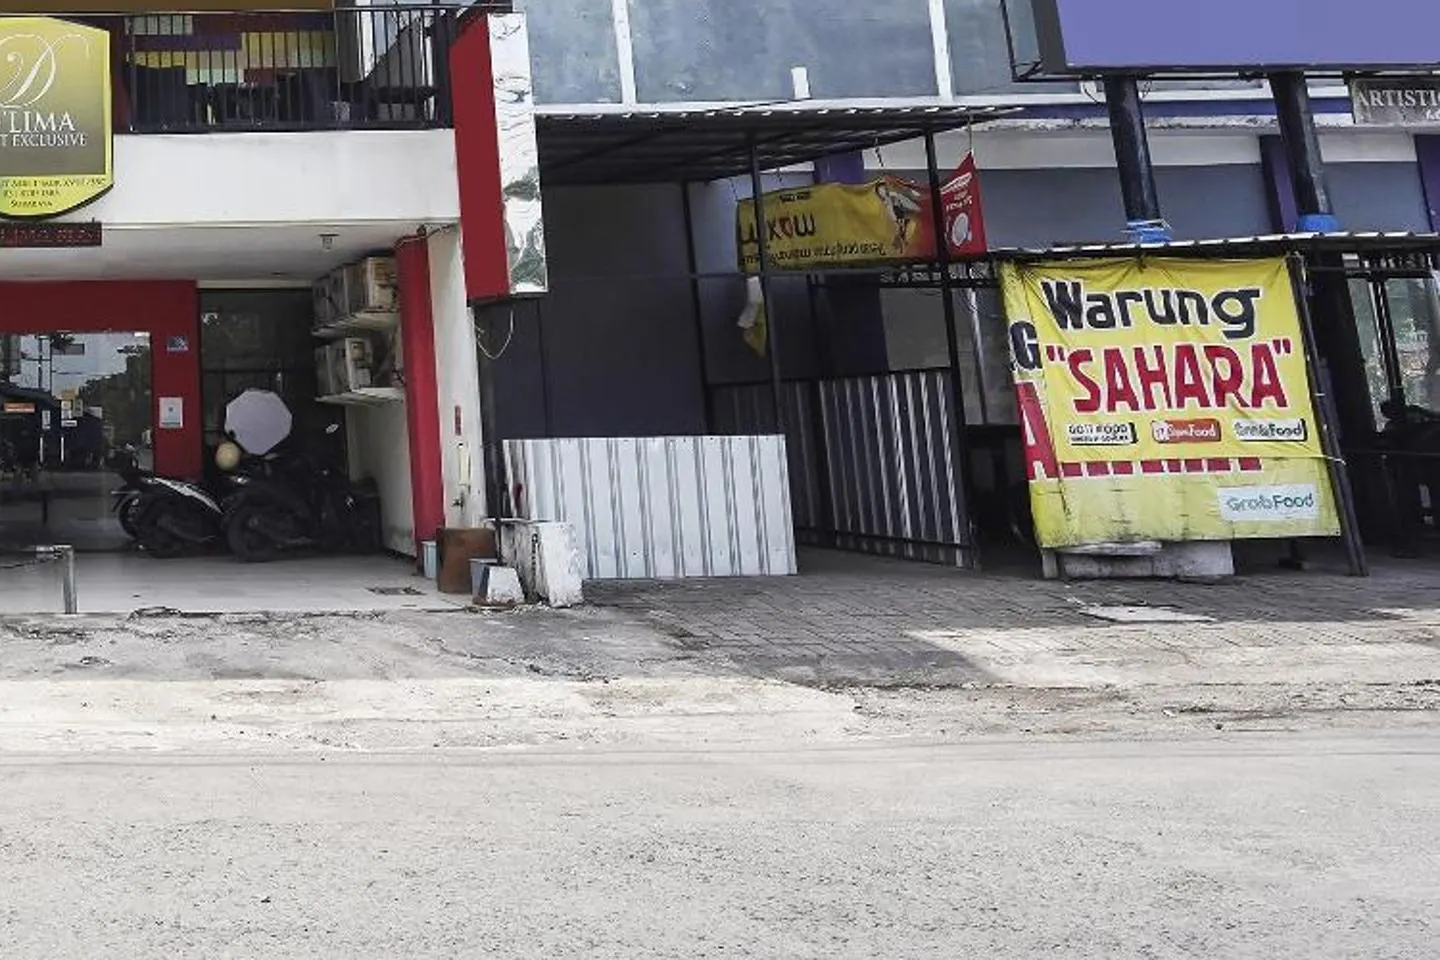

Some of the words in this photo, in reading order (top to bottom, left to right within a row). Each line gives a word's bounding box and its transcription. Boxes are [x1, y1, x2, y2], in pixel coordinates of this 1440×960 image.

[1356, 90, 1440, 106] ARTISTI
[13, 133, 88, 147] EXCLUSIVE
[1041, 280, 1262, 339] Warung
[1045, 338, 1291, 413] "SAHARA"
[1227, 493, 1315, 512] GrabFood
